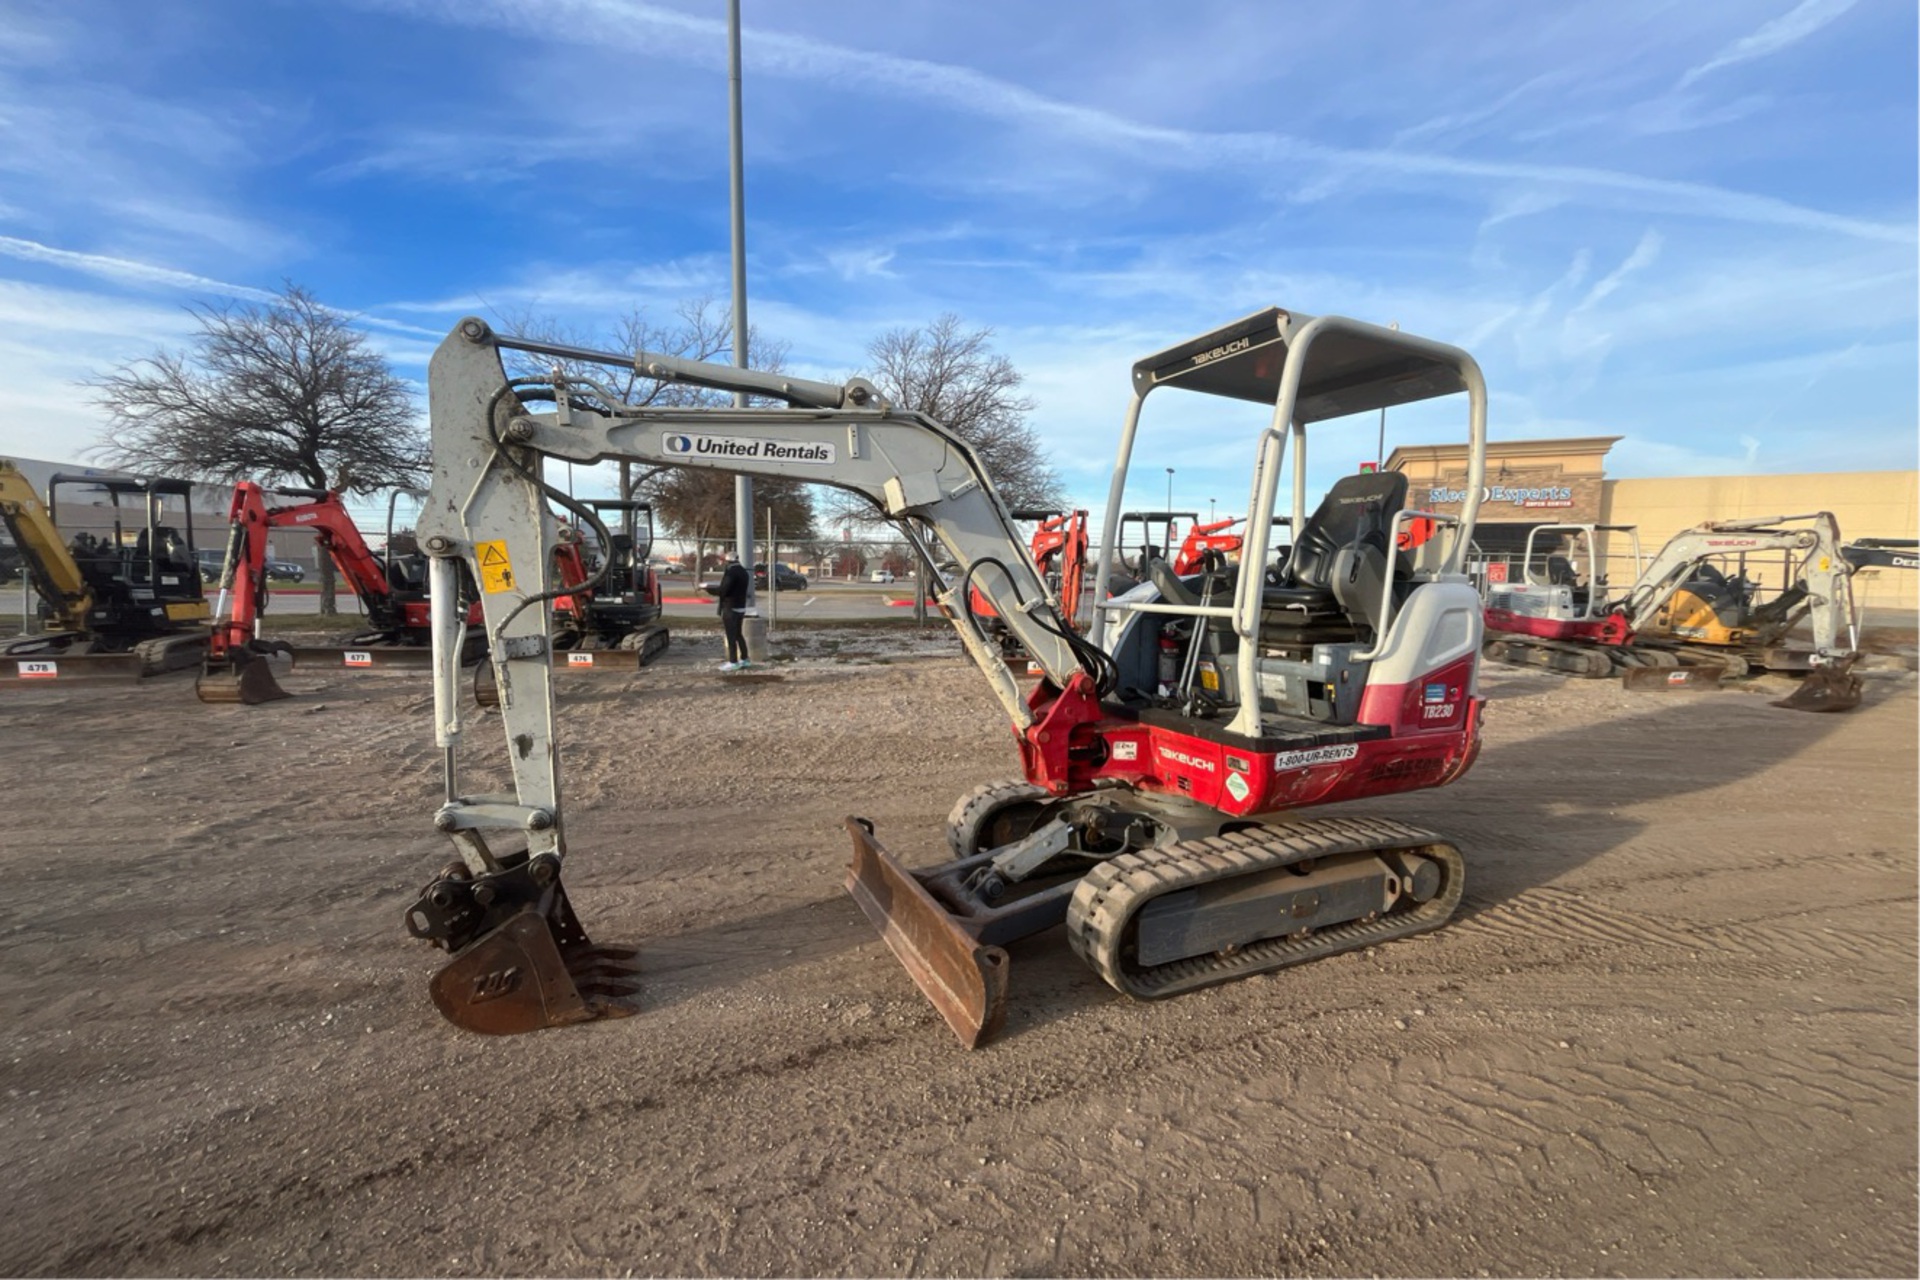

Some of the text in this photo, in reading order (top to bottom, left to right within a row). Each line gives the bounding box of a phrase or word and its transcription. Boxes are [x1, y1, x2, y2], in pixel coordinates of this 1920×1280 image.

[1191, 337, 1249, 365] TAKEUCHI
[696, 438, 829, 461] United Rentals
[1429, 486, 1571, 505] Slee Experts
[1423, 704, 1454, 719] TB230
[1158, 746, 1215, 773] TAKEUCHI
[1278, 747, 1355, 767] 1-800-UR-RENTS
